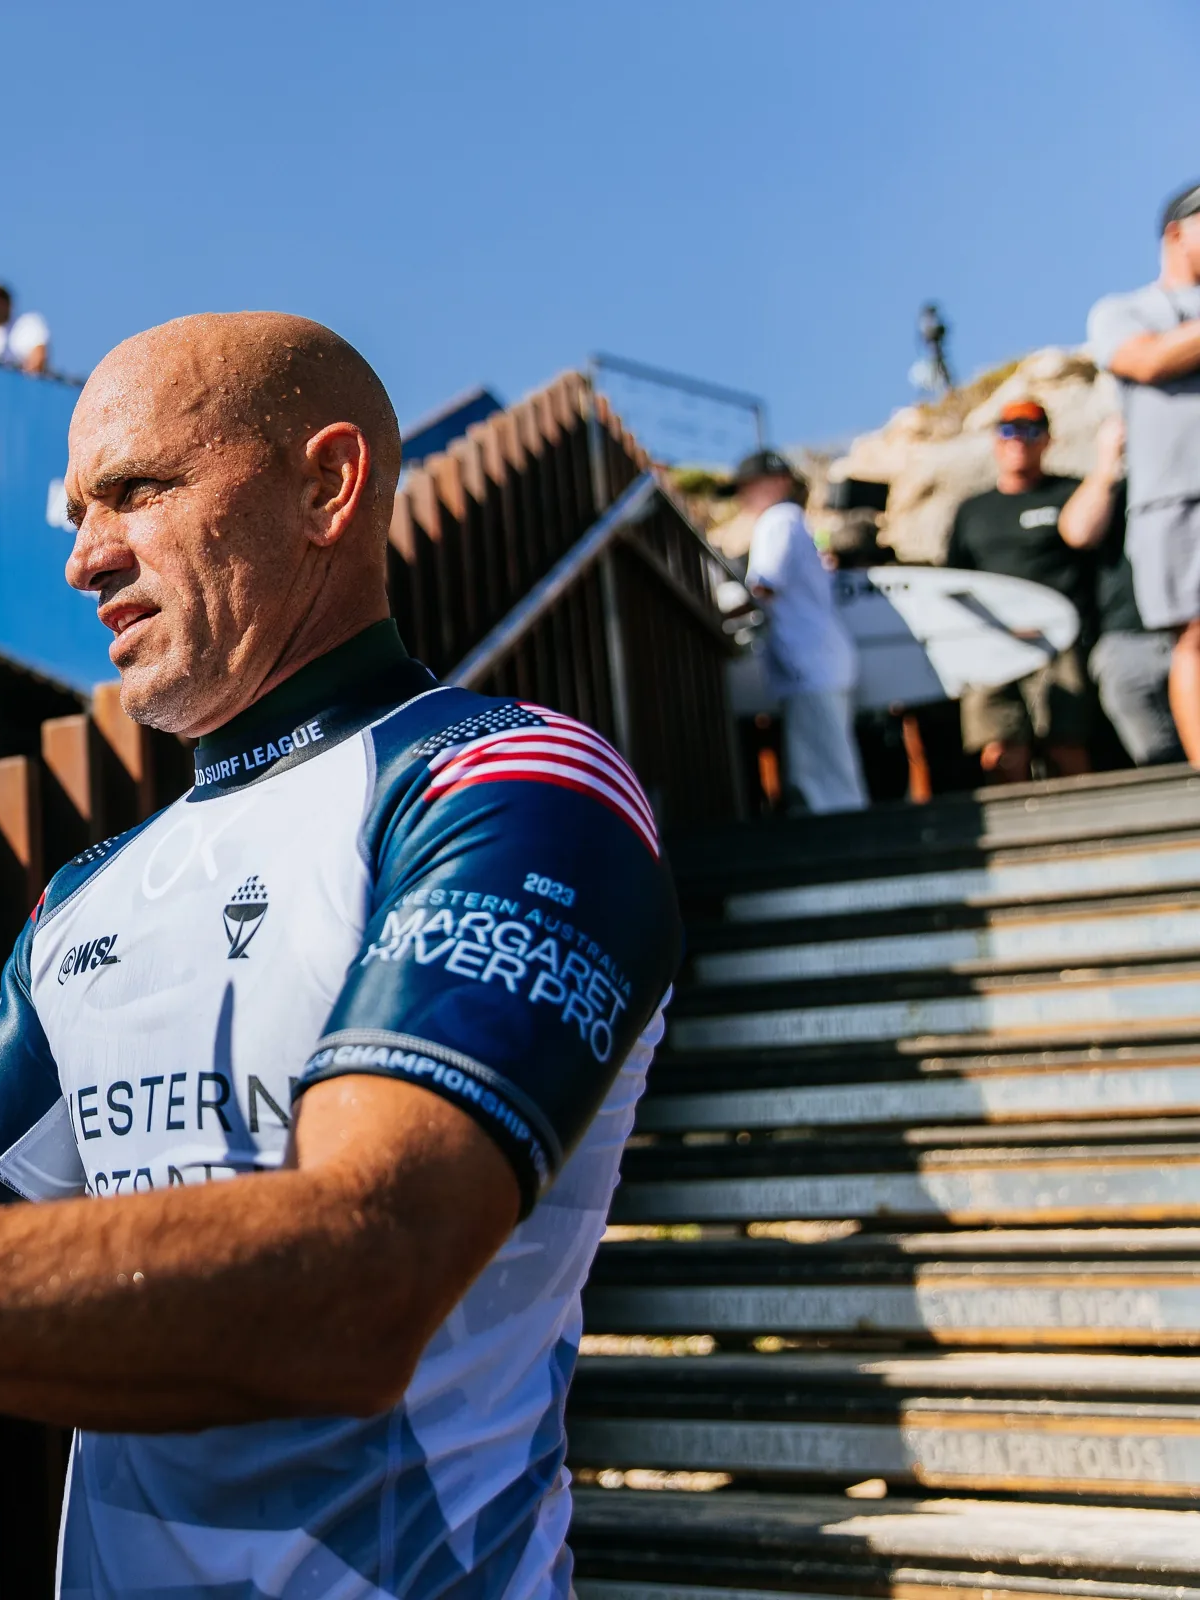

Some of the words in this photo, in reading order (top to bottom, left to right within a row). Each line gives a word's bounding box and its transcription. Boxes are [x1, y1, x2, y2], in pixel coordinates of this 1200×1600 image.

[206, 755, 240, 785] SURF
[243, 720, 325, 770] LEAGUE
[523, 872, 576, 908] 2023
[74, 933, 118, 976] WSL
[379, 907, 627, 1027] MARGARET
[524, 908, 632, 998] AUSTRALIA
[360, 933, 527, 994] RIVER
[528, 971, 613, 1064] PRO
[69, 1071, 299, 1145] ESTERN
[333, 1045, 531, 1140] CHAMPIONSHIP
